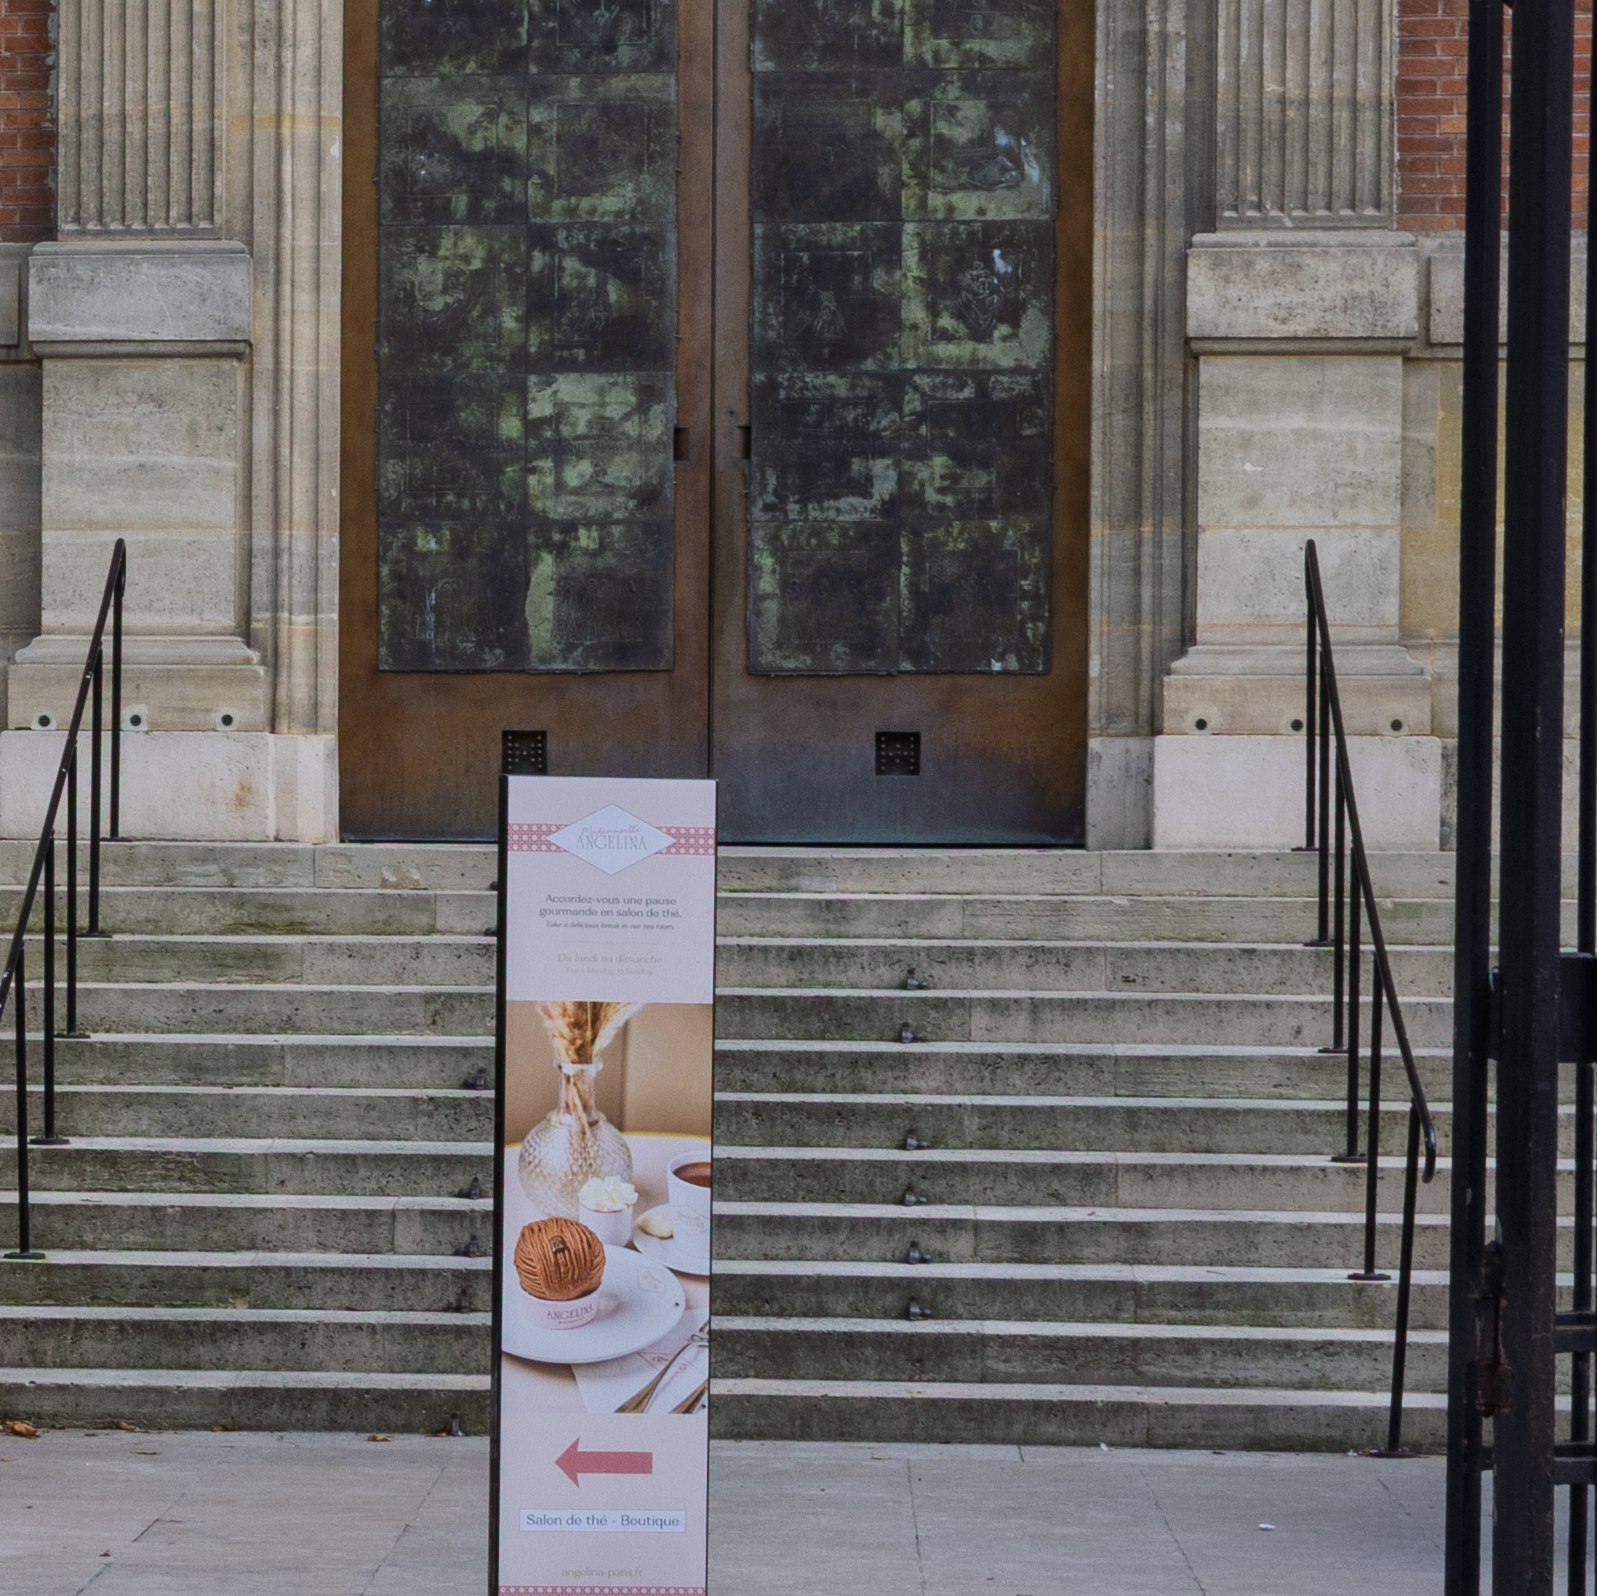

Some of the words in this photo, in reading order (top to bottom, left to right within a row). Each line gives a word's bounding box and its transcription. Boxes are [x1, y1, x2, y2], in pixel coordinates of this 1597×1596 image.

[576, 834, 647, 850] ANGELINA
[545, 894, 621, 905] Accordez-vous
[623, 897, 643, 905] une
[645, 897, 677, 907] pause
[539, 907, 597, 918] gourmande
[616, 907, 643, 917] salon
[646, 908, 659, 917] de
[526, 1513, 562, 1525] Salon
[566, 1514, 582, 1525] de
[586, 1514, 607, 1526] thé
[620, 1514, 679, 1529] Boutique
